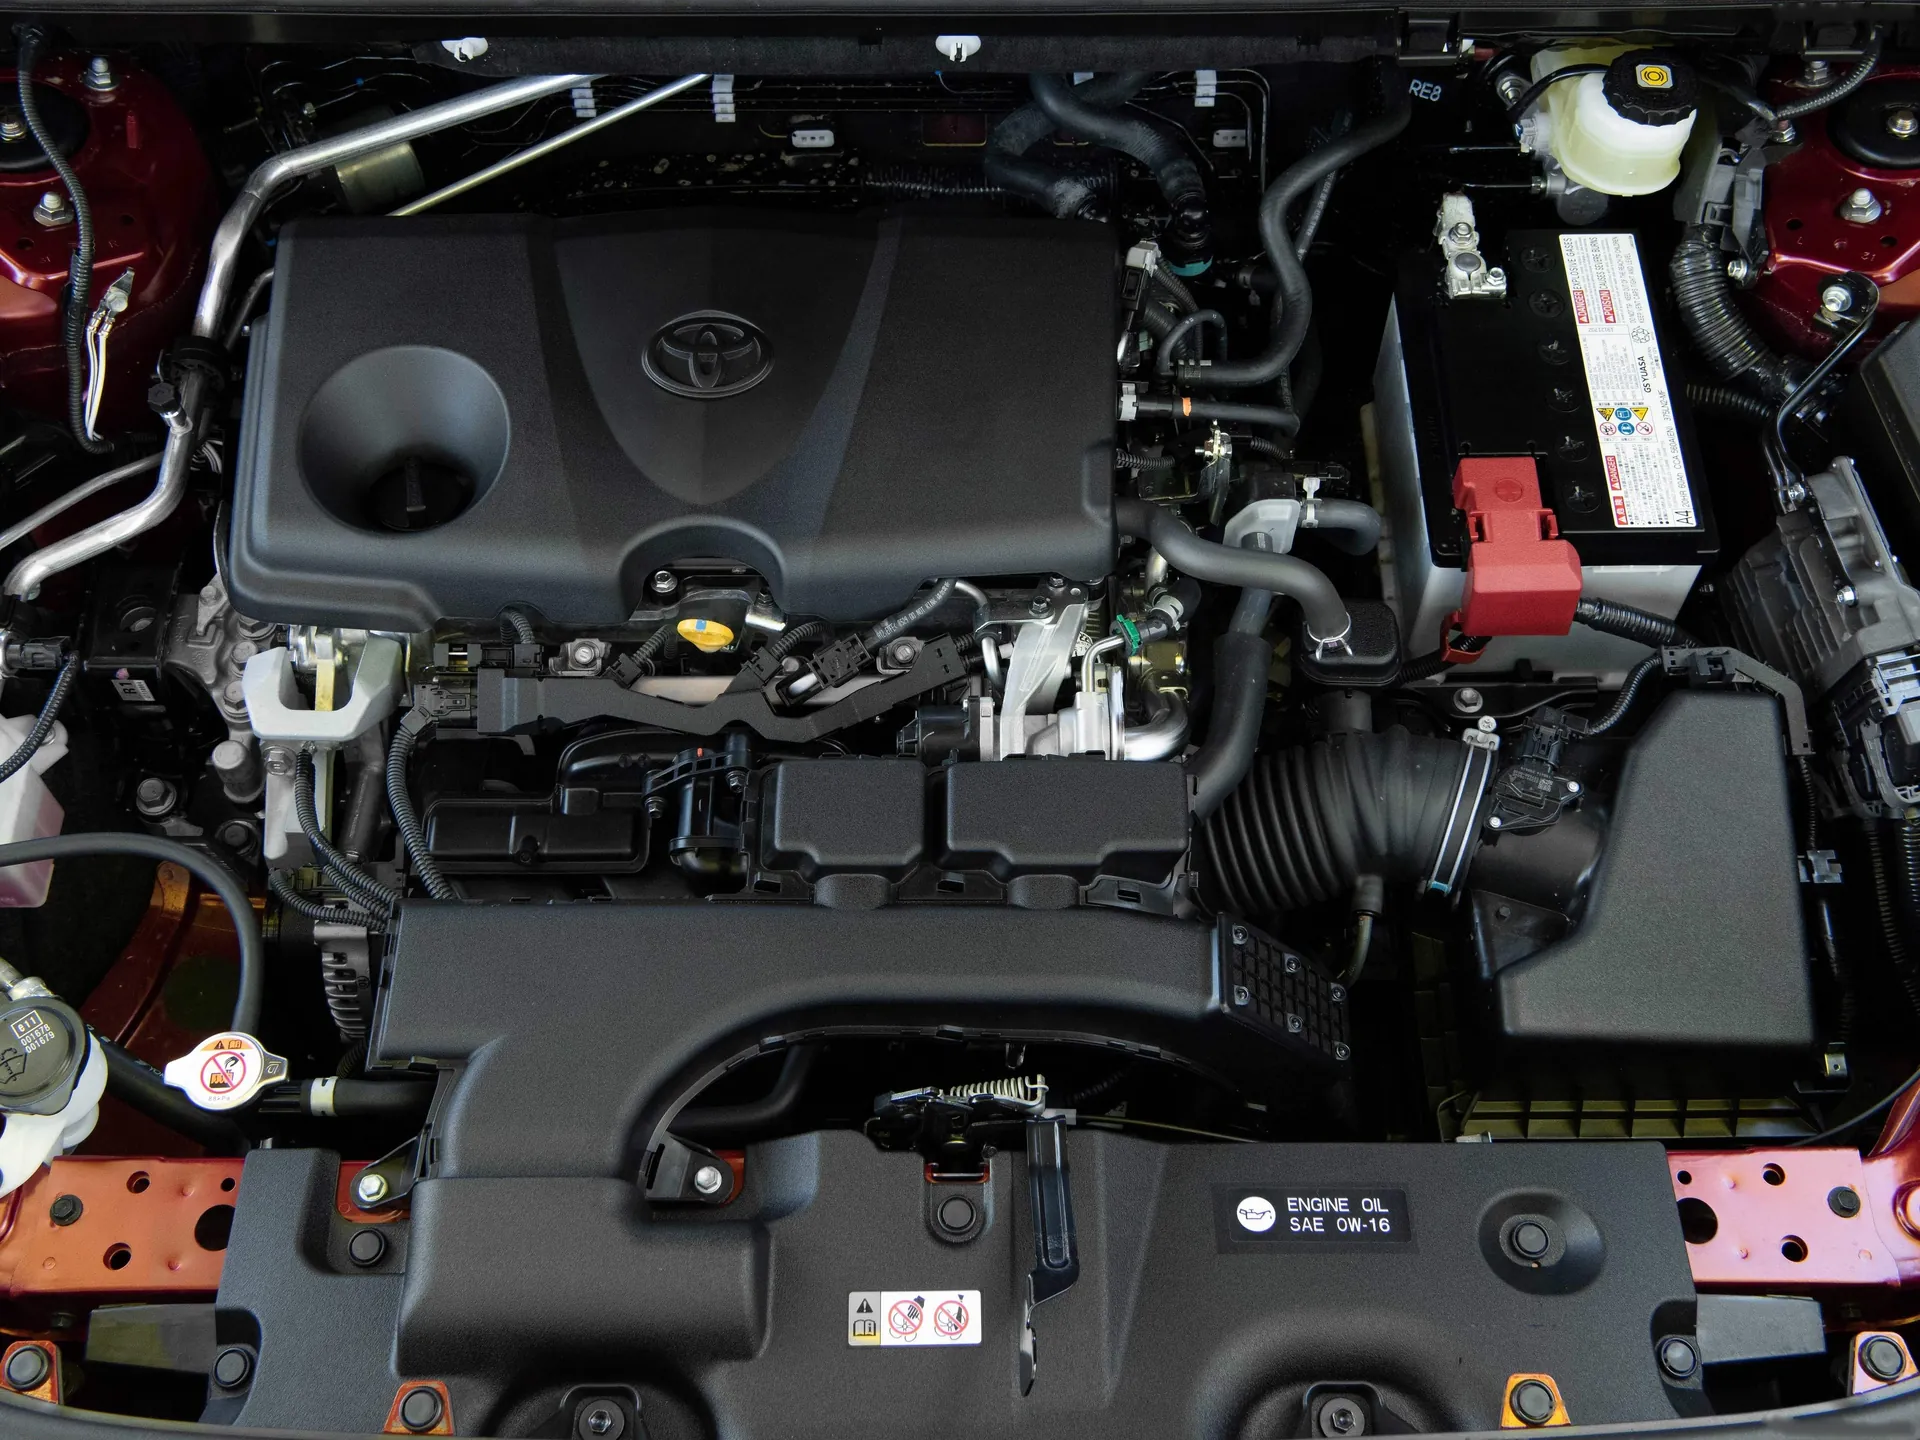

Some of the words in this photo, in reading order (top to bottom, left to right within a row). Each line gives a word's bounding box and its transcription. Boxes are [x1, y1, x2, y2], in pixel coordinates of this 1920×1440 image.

[1409, 79, 1441, 102] RE8
[1563, 237, 1574, 256] GASES
[1589, 237, 1600, 252] BURNS
[1612, 236, 1621, 252] CHILDREN
[1593, 253, 1604, 270] SEVERE
[1616, 259, 1625, 270] REACH
[1624, 252, 1632, 265] LEVEL
[1568, 258, 1581, 289] EXPLOSIVE
[1627, 265, 1635, 274] AND
[1597, 271, 1608, 289] CAUSES
[1629, 275, 1638, 287] TIGHT
[1632, 288, 1640, 299] CAPS
[1574, 291, 1586, 315] DANGER
[1601, 290, 1613, 315] POISON
[1634, 300, 1643, 311] VENT
[1637, 312, 1646, 323] KEEP
[1637, 355, 1649, 382] YUASA
[1643, 382, 1651, 392] GS
[1657, 389, 1671, 421] 375LN2-MF
[1666, 425, 1678, 453] 560A(EN)
[1607, 456, 1618, 482] DANGER
[1672, 455, 1682, 469] CCA
[1679, 490, 1690, 507] 20HR
[1674, 509, 1694, 524] A4
[916, 606, 926, 616] NOT
[925, 598, 937, 609] KINK
[119, 682, 137, 694] R1
[17, 1016, 38, 1033] e11
[20, 1023, 51, 1046] 001678
[25, 1031, 56, 1054] 001679
[1287, 1197, 1350, 1213] ENGINE
[1361, 1197, 1389, 1213] OIL
[1289, 1217, 1325, 1232] SAE
[1336, 1217, 1391, 1233] 0W-16
